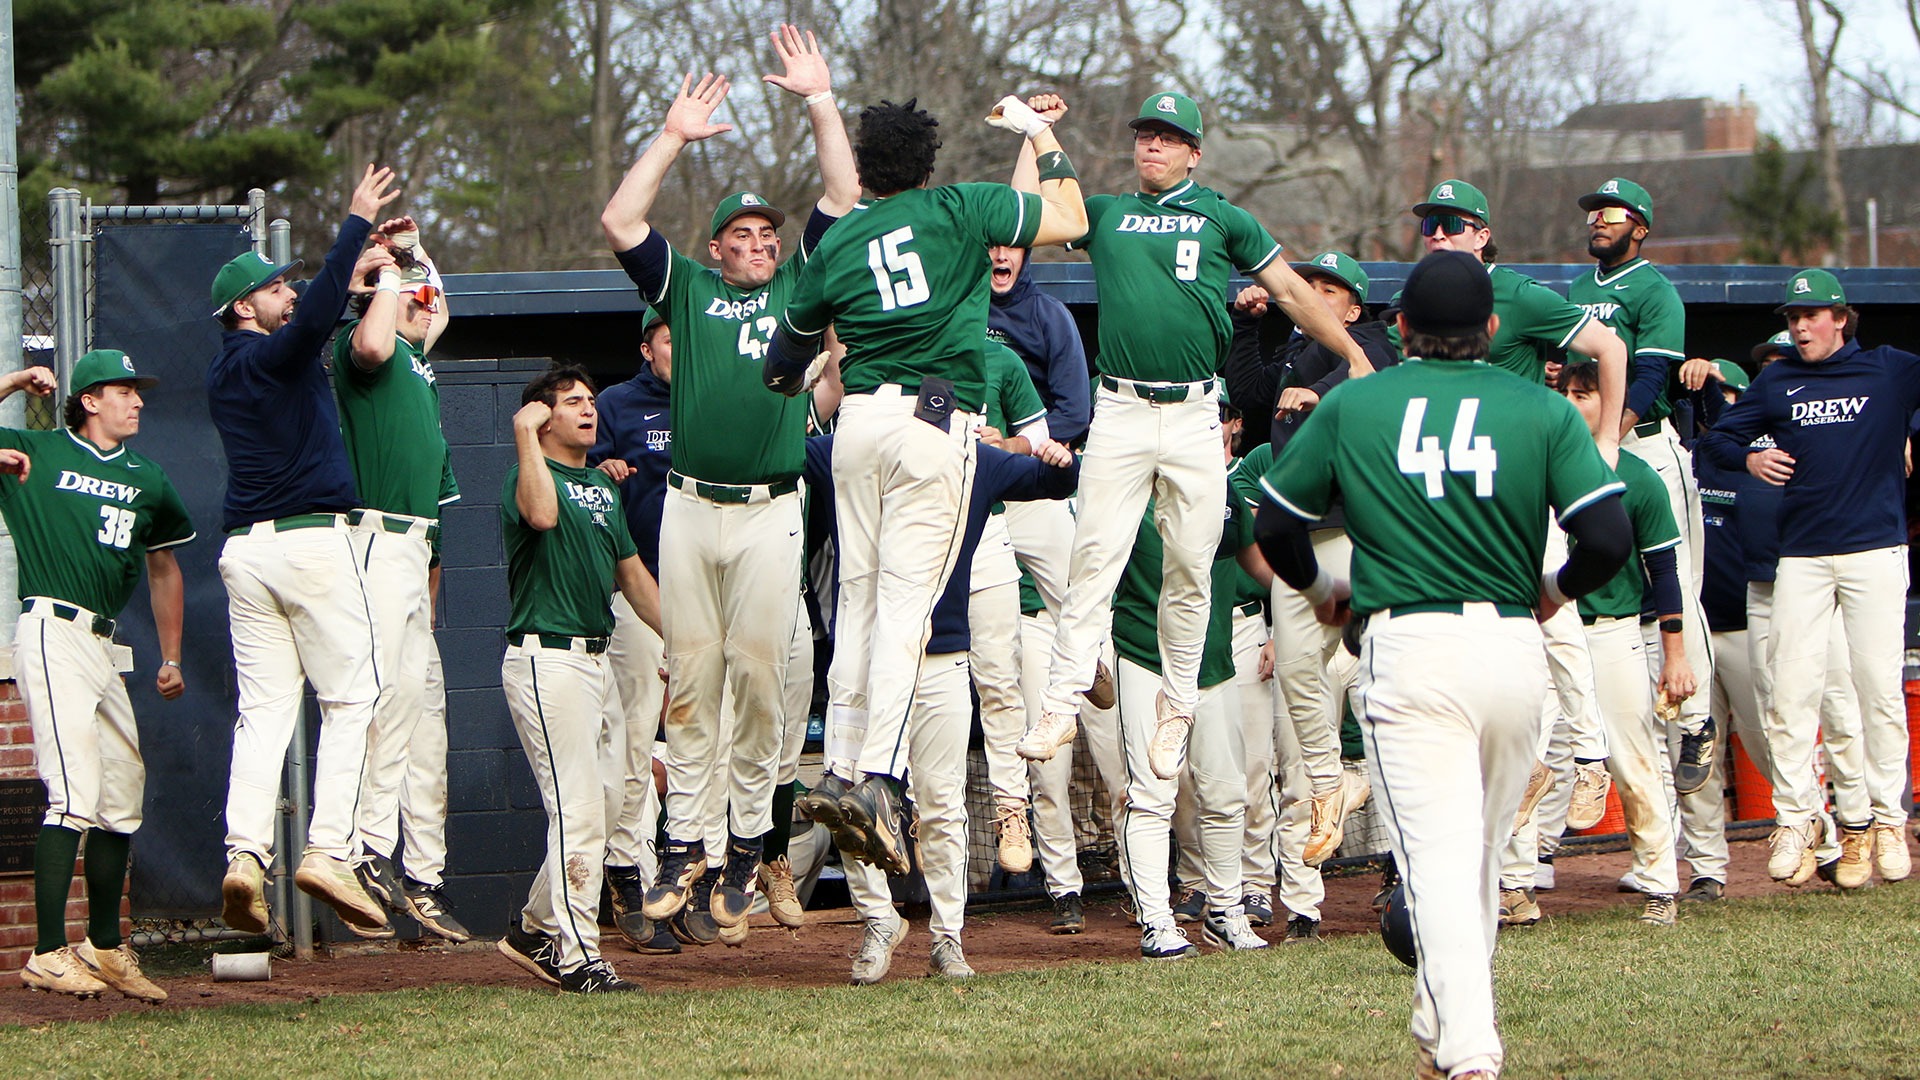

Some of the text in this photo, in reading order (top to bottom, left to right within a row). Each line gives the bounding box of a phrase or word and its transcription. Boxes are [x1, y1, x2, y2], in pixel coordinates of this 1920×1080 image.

[1115, 214, 1207, 234] DREW
[866, 224, 931, 312] 15
[1175, 239, 1201, 282] 9
[1791, 396, 1870, 421] DREW
[1800, 414, 1855, 427] BASEBALL
[1397, 397, 1497, 499] 44
[55, 470, 142, 504] DREW
[98, 504, 137, 549] 38
